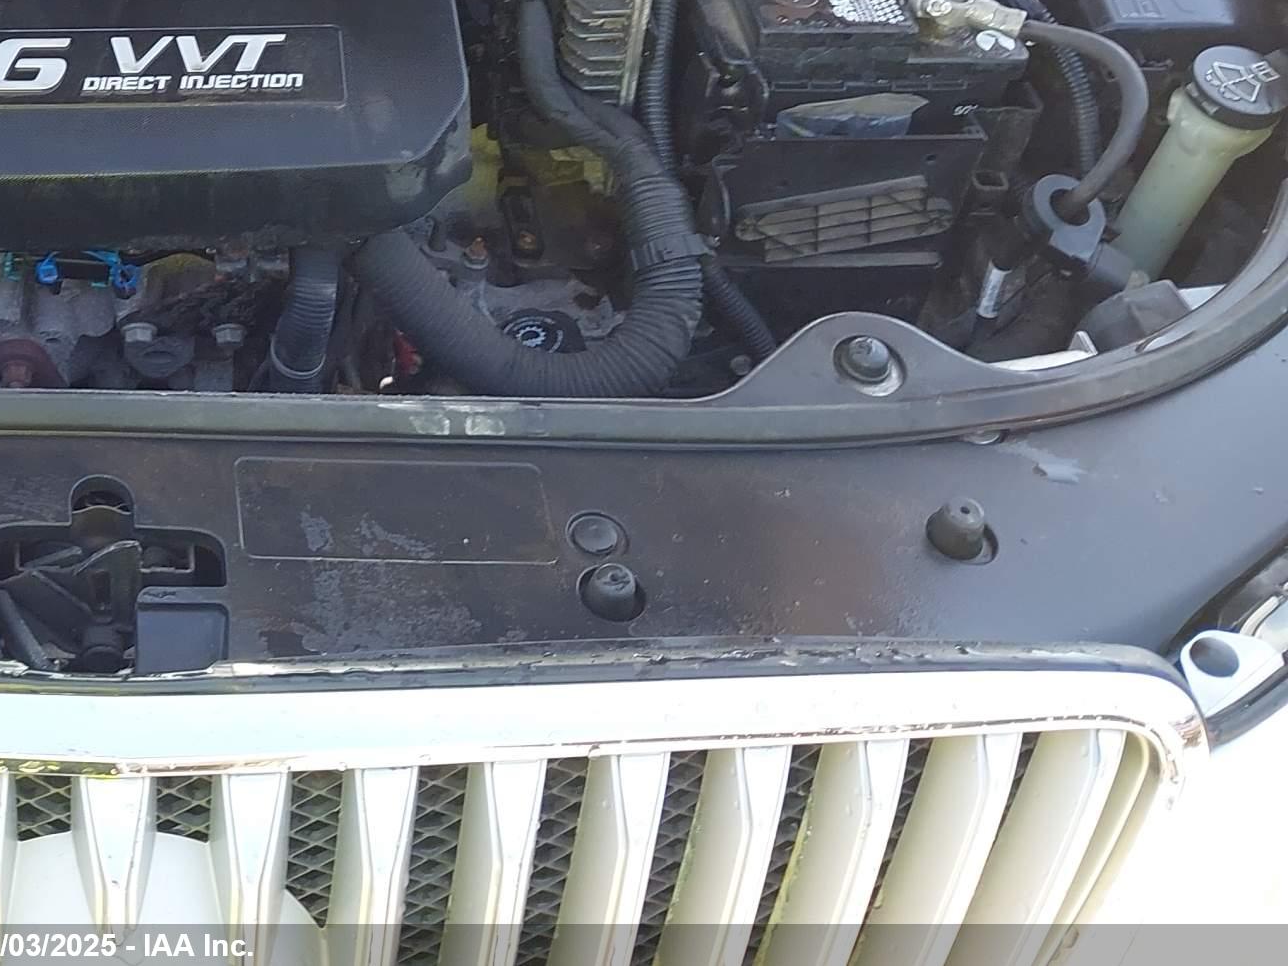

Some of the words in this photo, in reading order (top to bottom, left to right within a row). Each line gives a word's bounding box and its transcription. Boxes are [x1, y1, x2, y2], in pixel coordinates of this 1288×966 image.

[109, 32, 287, 74] VVT
[81, 73, 171, 92] DIRECT
[178, 72, 304, 90] INJECTION
